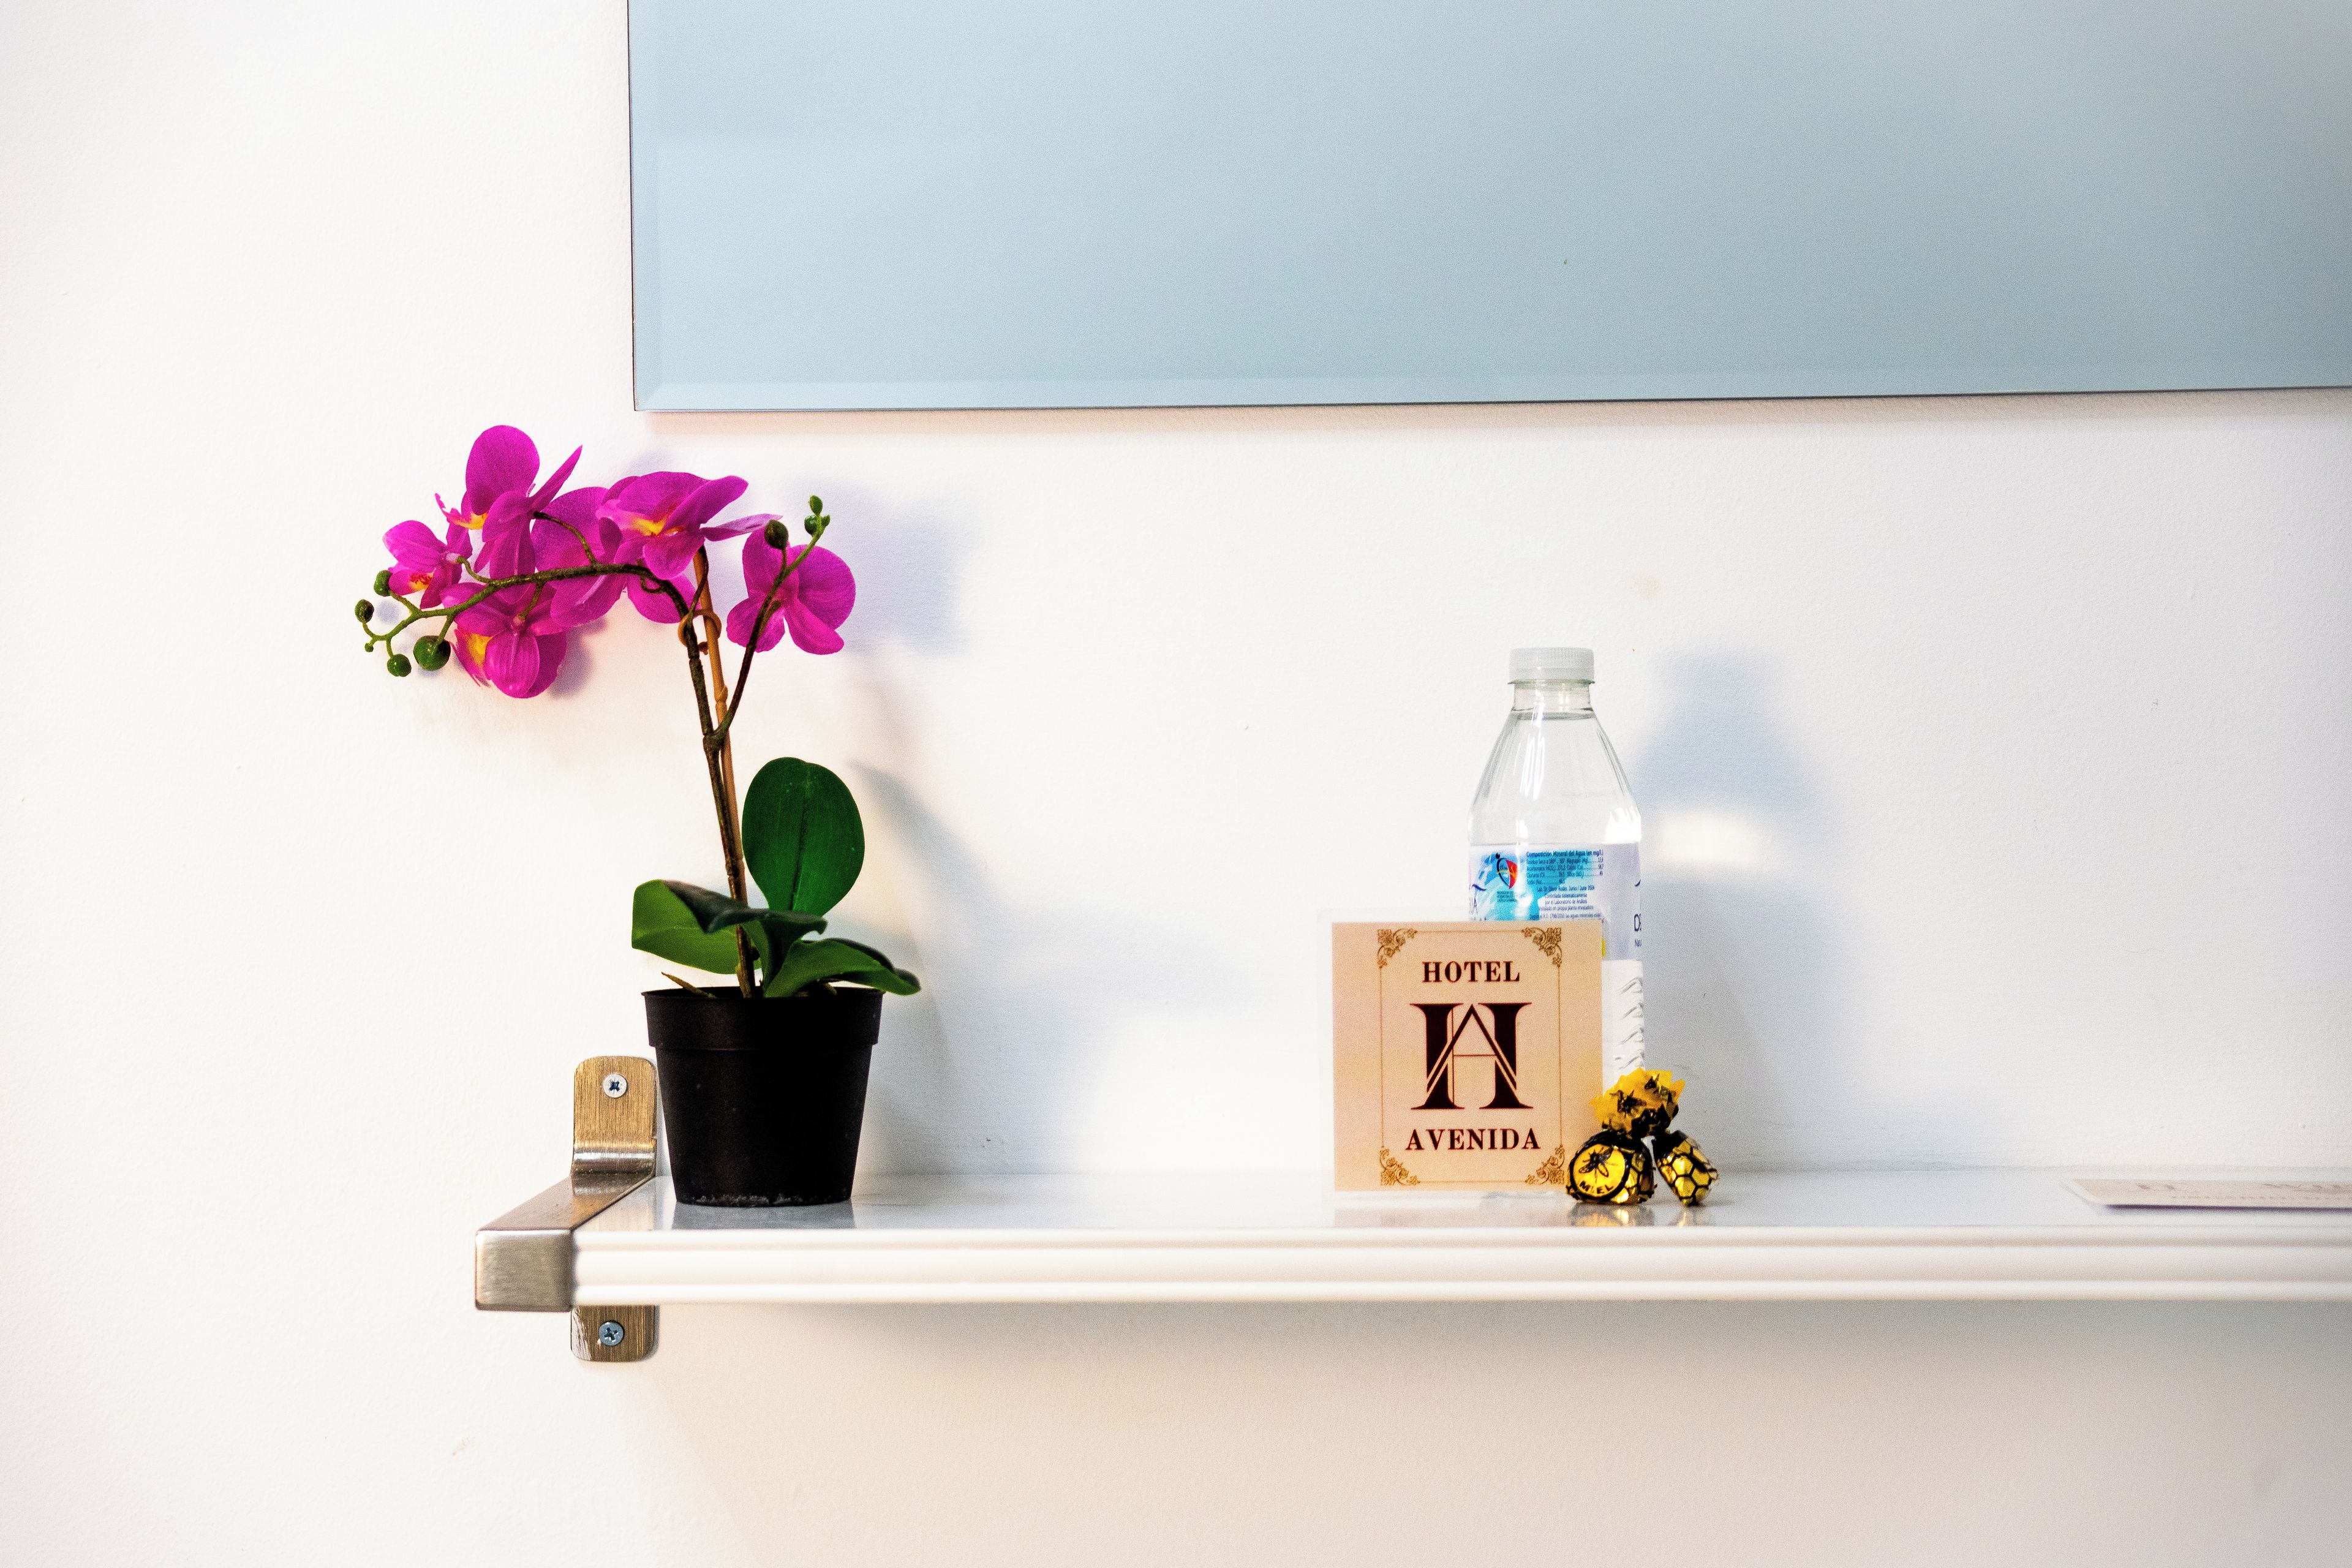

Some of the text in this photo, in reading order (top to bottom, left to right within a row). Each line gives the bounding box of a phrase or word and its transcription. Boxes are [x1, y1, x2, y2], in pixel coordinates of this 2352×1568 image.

[1422, 960, 1520, 982] HOTEL
[1405, 1128, 1541, 1151] AVENIDA
[1580, 1180, 1615, 1194] MIEL
